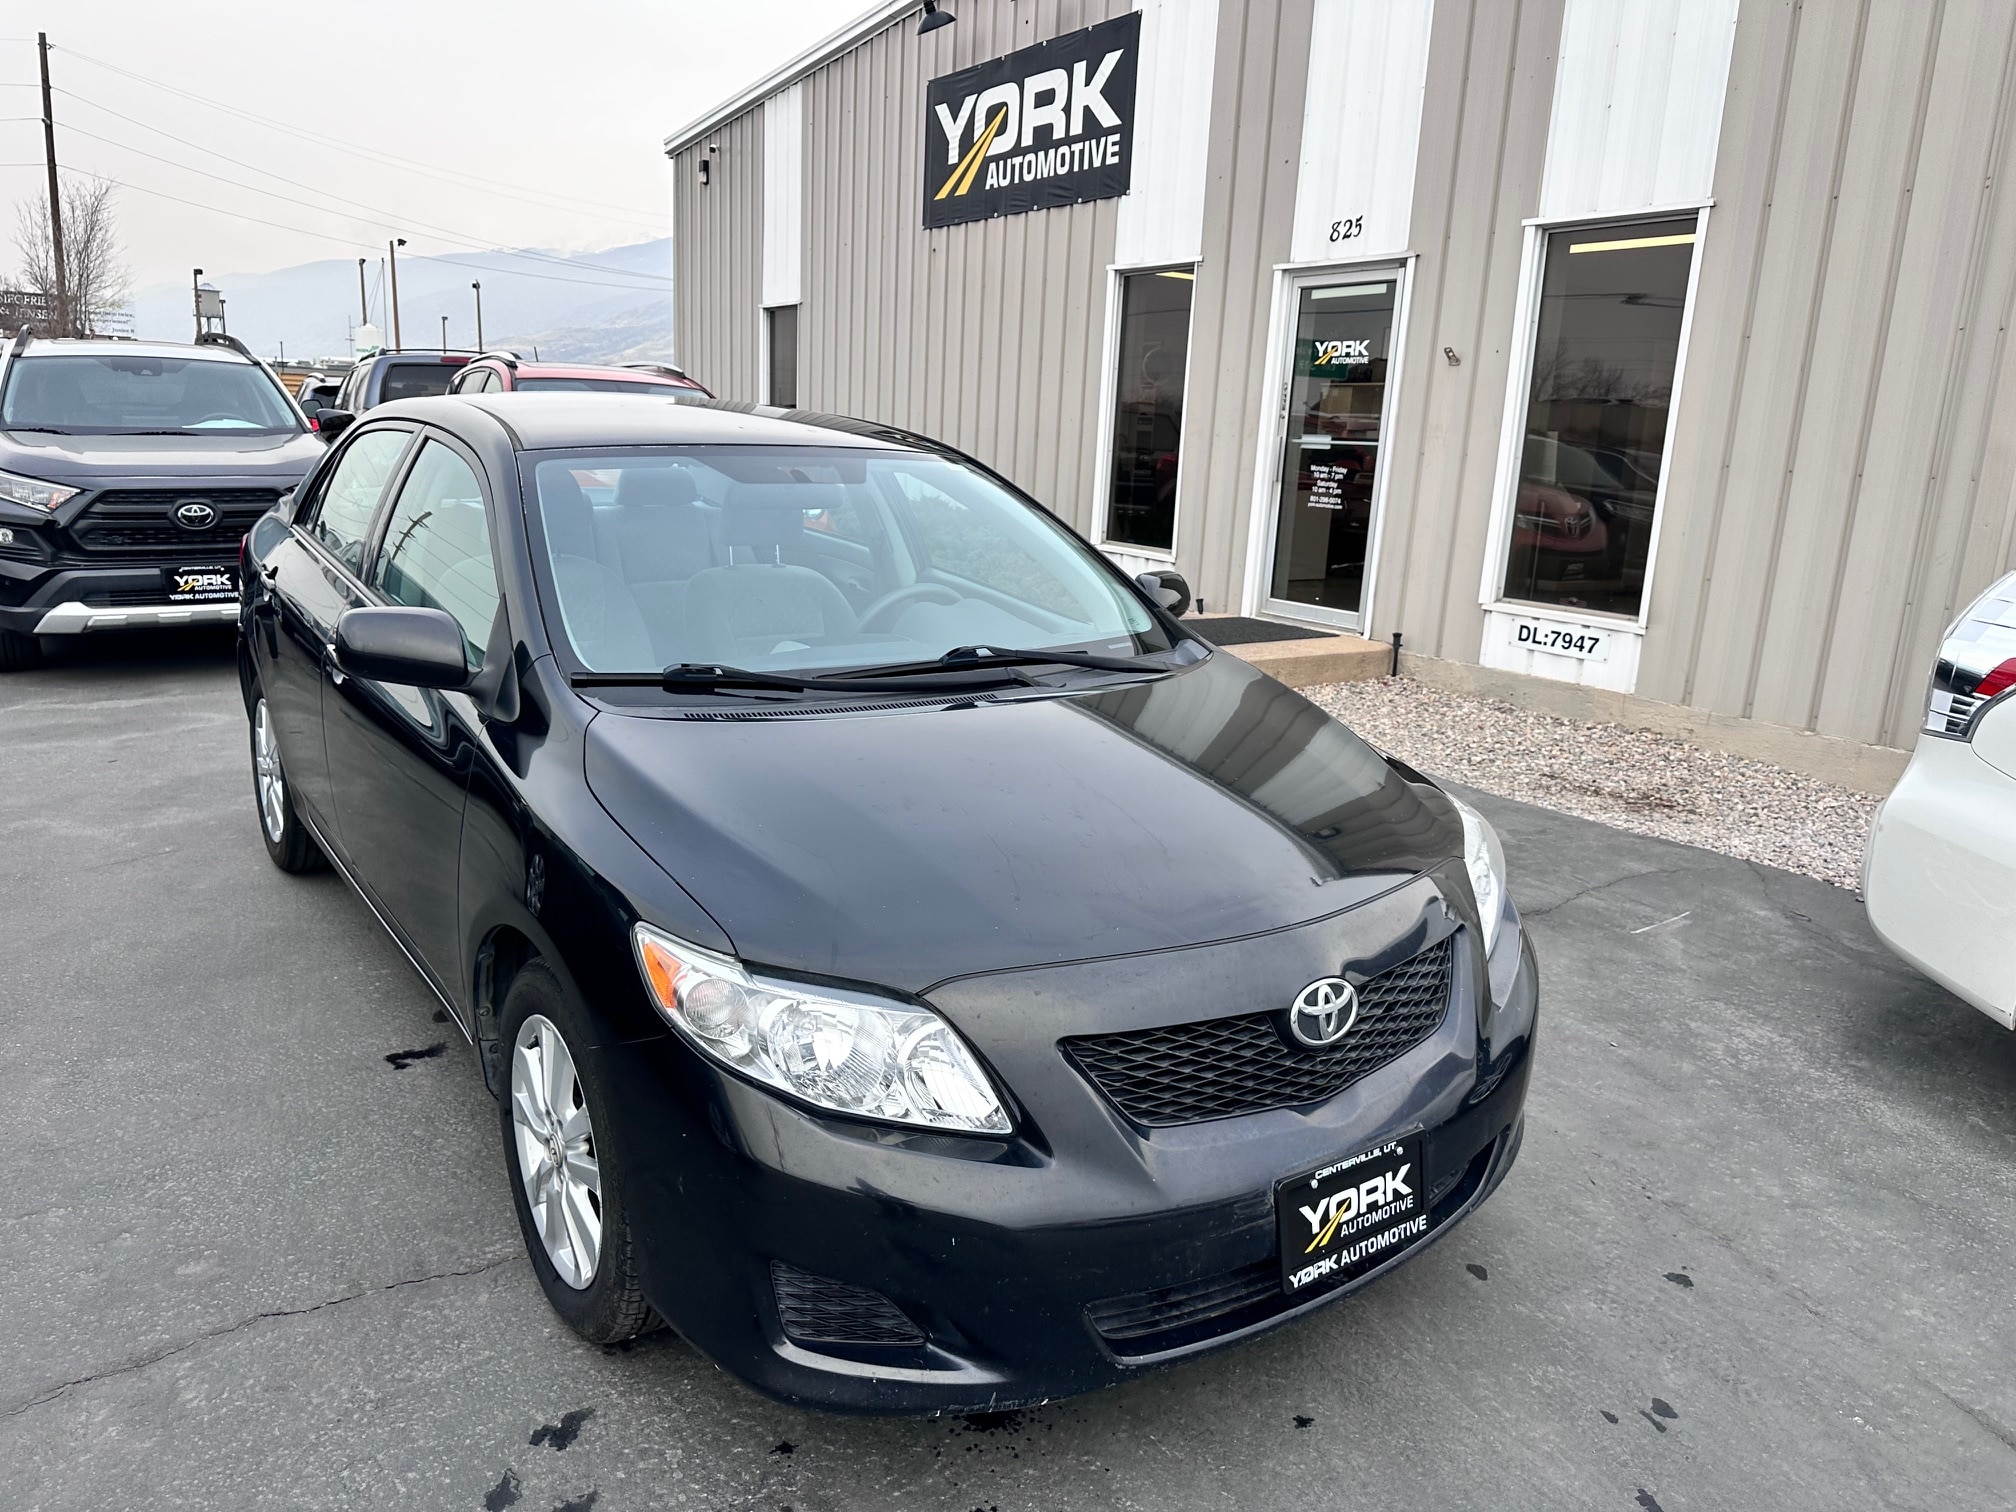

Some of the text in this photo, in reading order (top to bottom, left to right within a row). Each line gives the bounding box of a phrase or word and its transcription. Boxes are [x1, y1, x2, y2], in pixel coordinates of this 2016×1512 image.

[934, 48, 1125, 166] YORK
[984, 133, 1121, 191] AUTOMOTIVE
[1329, 214, 1363, 242] 825
[1314, 339, 1371, 357] YORK
[1311, 465, 1329, 473] Monday
[1333, 466, 1347, 474] Friday
[1317, 480, 1338, 488] Saturday
[173, 573, 232, 586] YORK
[195, 592, 239, 600] AUTOMOTIVE
[1517, 624, 1600, 654] DL:7947
[1314, 1141, 1397, 1180] CENTERVILLE, UT
[1299, 1162, 1414, 1235] YORK
[1340, 1195, 1414, 1238] AUTOMOTIVE
[1288, 1214, 1427, 1289] YORK AUTOMOTIVE
